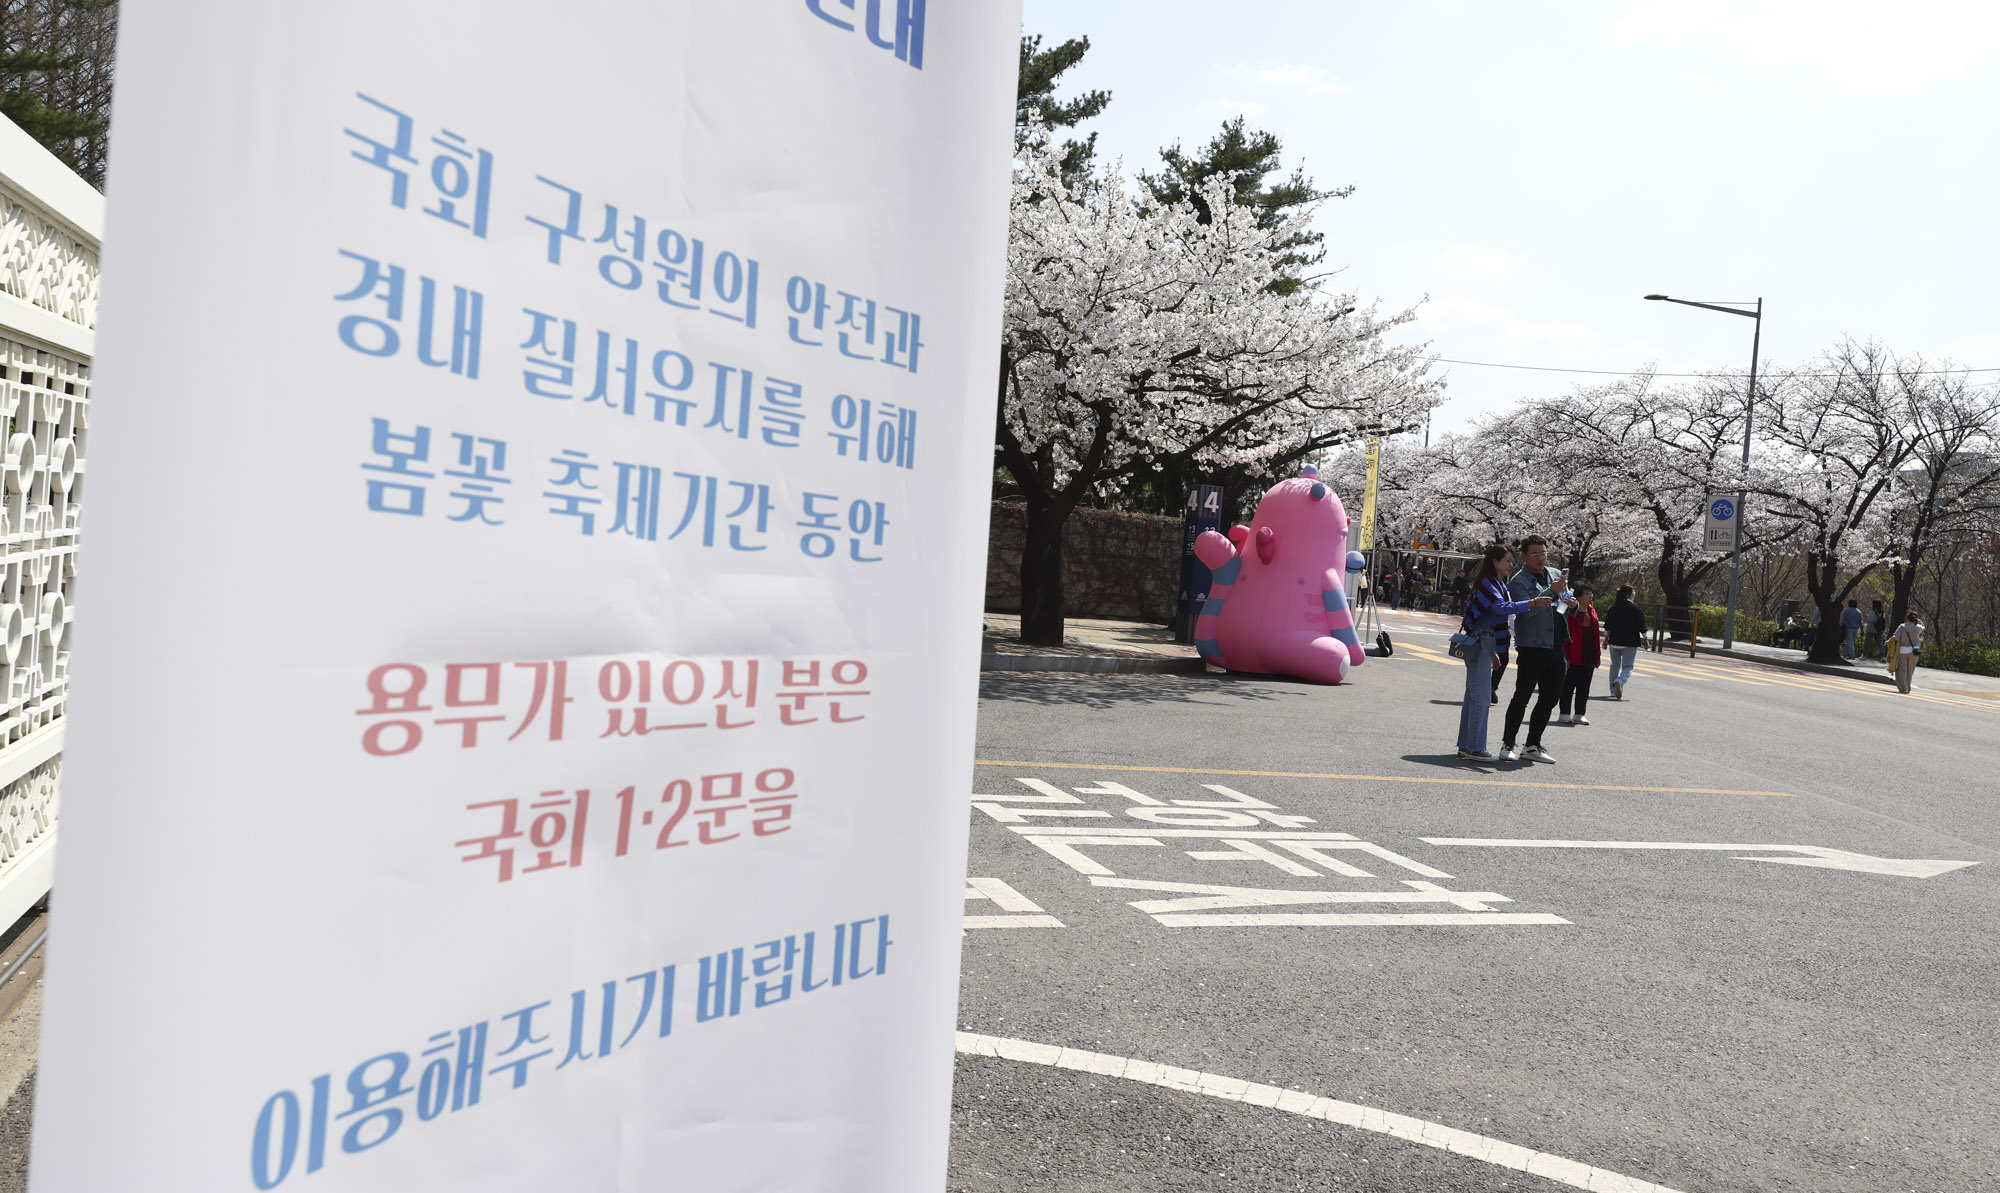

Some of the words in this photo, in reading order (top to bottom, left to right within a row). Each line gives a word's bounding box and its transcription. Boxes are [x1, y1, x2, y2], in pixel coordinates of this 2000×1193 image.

[344, 93, 494, 240] 국회
[525, 175, 760, 330] 구성원의
[786, 276, 925, 375] 안전과
[335, 249, 484, 381] 경내
[520, 308, 807, 449] 질서유지를
[828, 394, 918, 471] 위해
[361, 417, 512, 527] 봄꽃
[543, 449, 776, 553] 축제기간
[796, 492, 891, 564] 동안
[1187, 490, 1198, 511] 4
[1204, 491, 1219, 513] 4
[357, 661, 573, 757] 용무가
[599, 660, 759, 738] 있으신
[777, 660, 871, 727] 분은
[455, 789, 591, 883] 국회
[251, 964, 677, 1192] 이용해주시기
[696, 914, 894, 1024] 바랍니다
